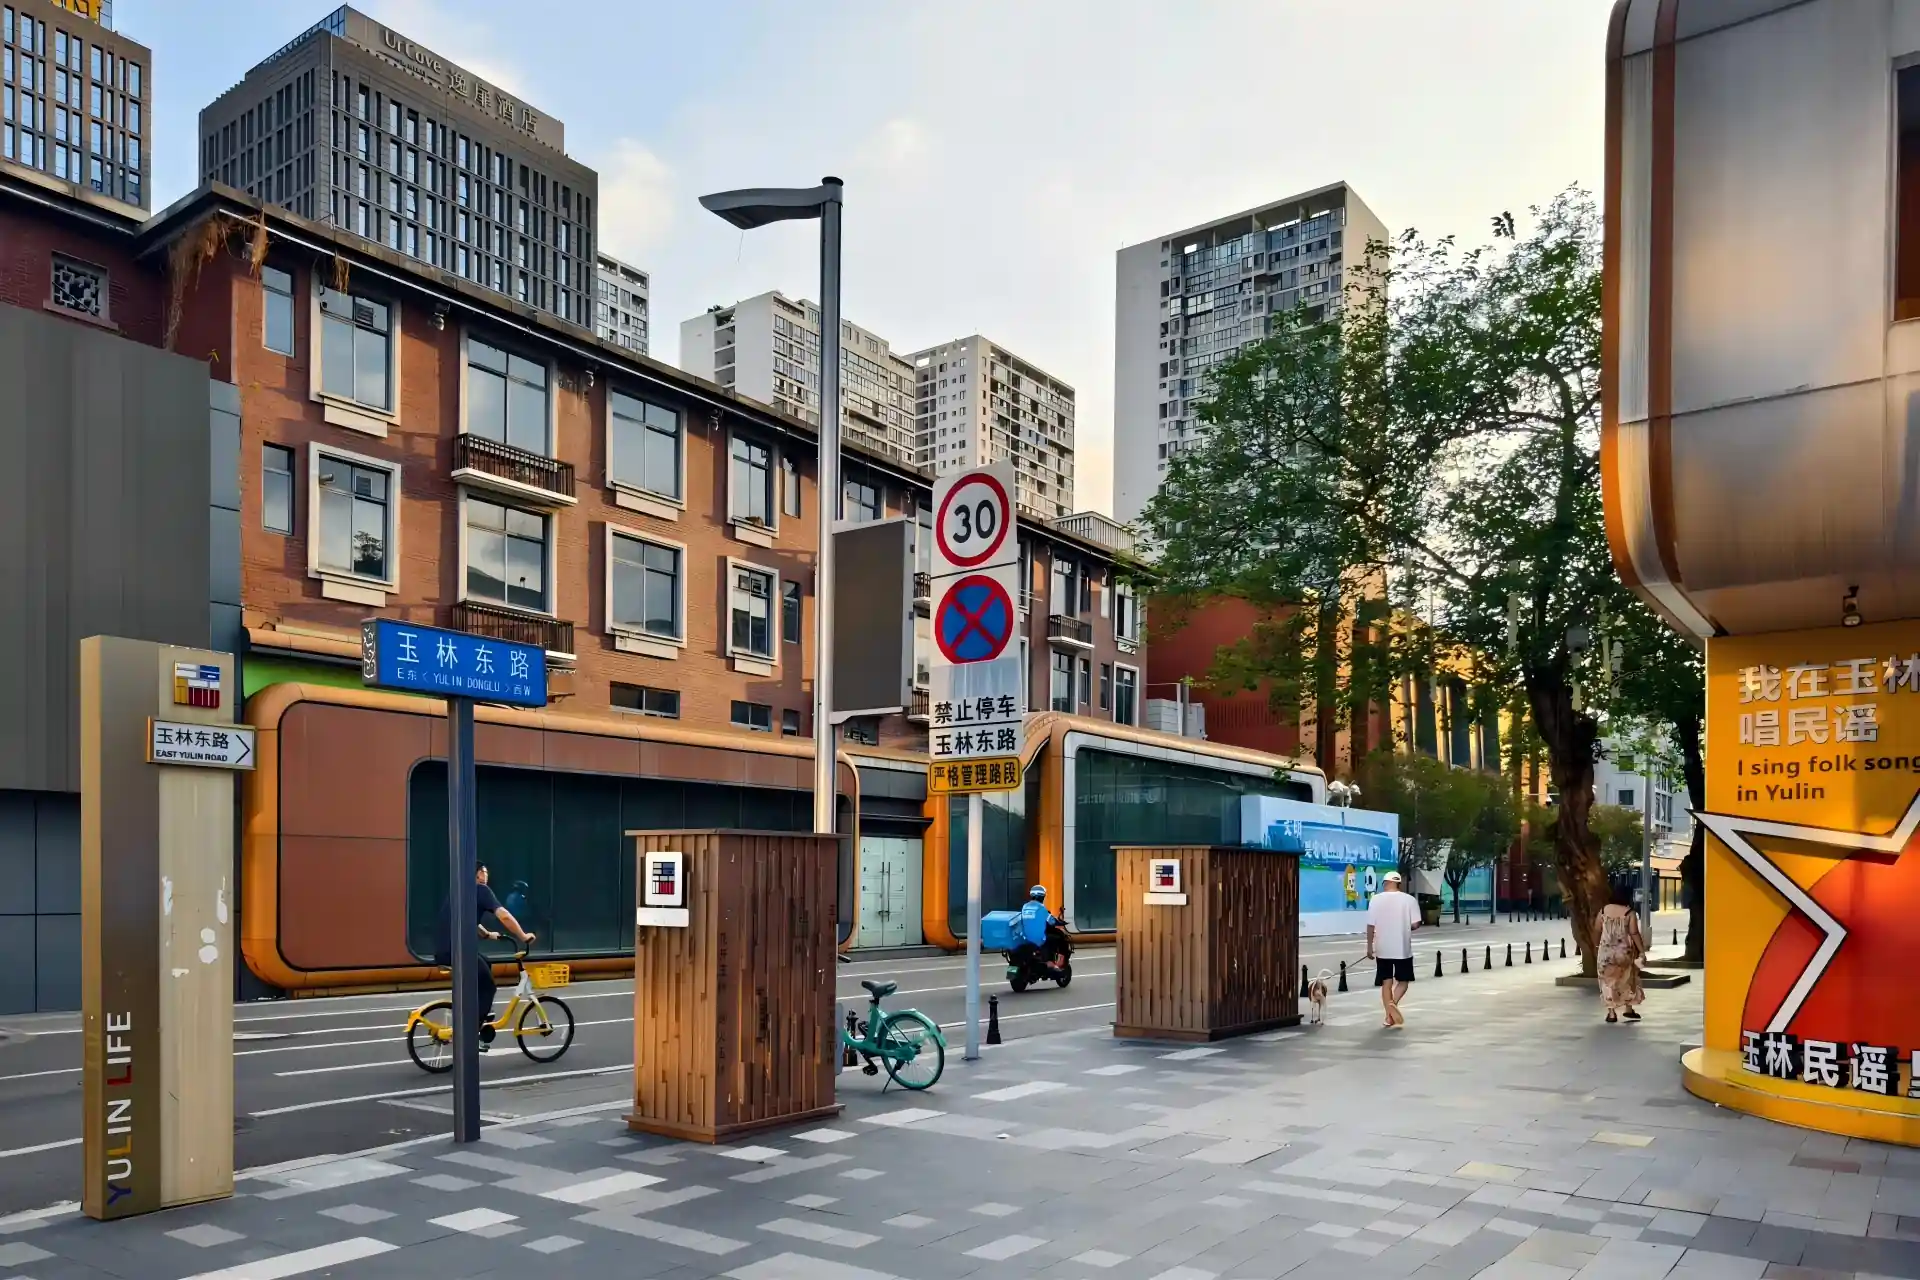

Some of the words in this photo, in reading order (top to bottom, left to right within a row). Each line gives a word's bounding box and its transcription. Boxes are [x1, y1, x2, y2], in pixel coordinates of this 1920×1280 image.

[384, 29, 442, 75] UrCove
[446, 70, 538, 134] 逸扉酒店
[953, 499, 996, 544] 30
[397, 631, 530, 680] 玉林东路
[433, 672, 462, 687] YULIN
[467, 677, 500, 693] DONGLU
[1737, 652, 1920, 704] 我在玉林
[935, 694, 1016, 724] 禁止停车
[1738, 703, 1879, 747] 唱民谣
[155, 727, 229, 750] 玉林东路
[155, 749, 177, 758] EAST
[180, 751, 204, 760] YULIN
[204, 753, 228, 762] ROAD
[935, 728, 1017, 755] 玉林东路
[934, 761, 1017, 788] 严格管理路段
[1737, 759, 1743, 776] I
[1751, 758, 1801, 779] sing
[1808, 754, 1858, 773] folk
[1737, 785, 1758, 802] in
[1765, 782, 1825, 801] Yulin
[106, 1011, 132, 1087] LIFE
[106, 1098, 132, 1206] YULIN
